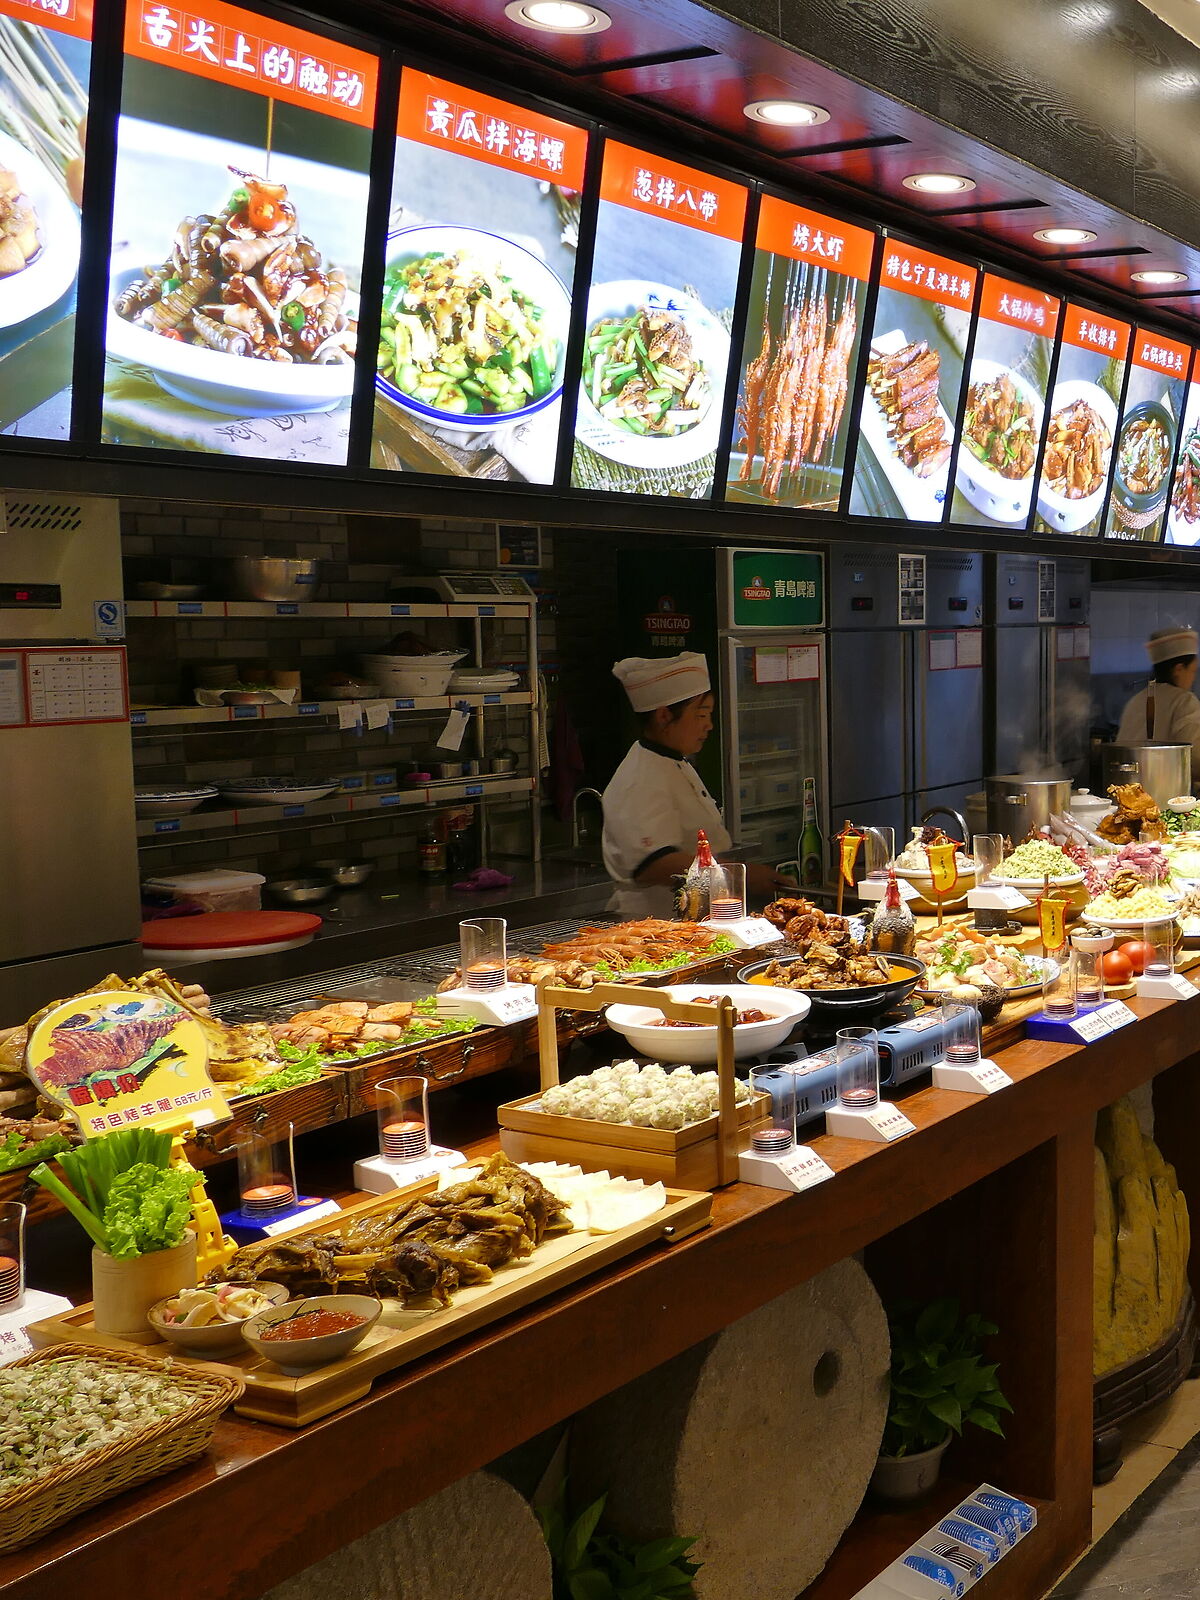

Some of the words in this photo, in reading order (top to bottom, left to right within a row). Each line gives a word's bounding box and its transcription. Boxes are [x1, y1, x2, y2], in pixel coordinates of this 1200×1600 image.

[144, 7, 363, 107] 舌尖上的触动
[793, 224, 844, 261] 烤大虾
[886, 254, 971, 300] 特色宁夏滩羊排
[998, 294, 1046, 326] 大锅炒鸡
[1079, 320, 1117, 351] 丰收排骨
[743, 589, 771, 598] TSINGTAO
[645, 618, 690, 630] TSINGTAO
[90, 1097, 173, 1132] 特色烤羊腿
